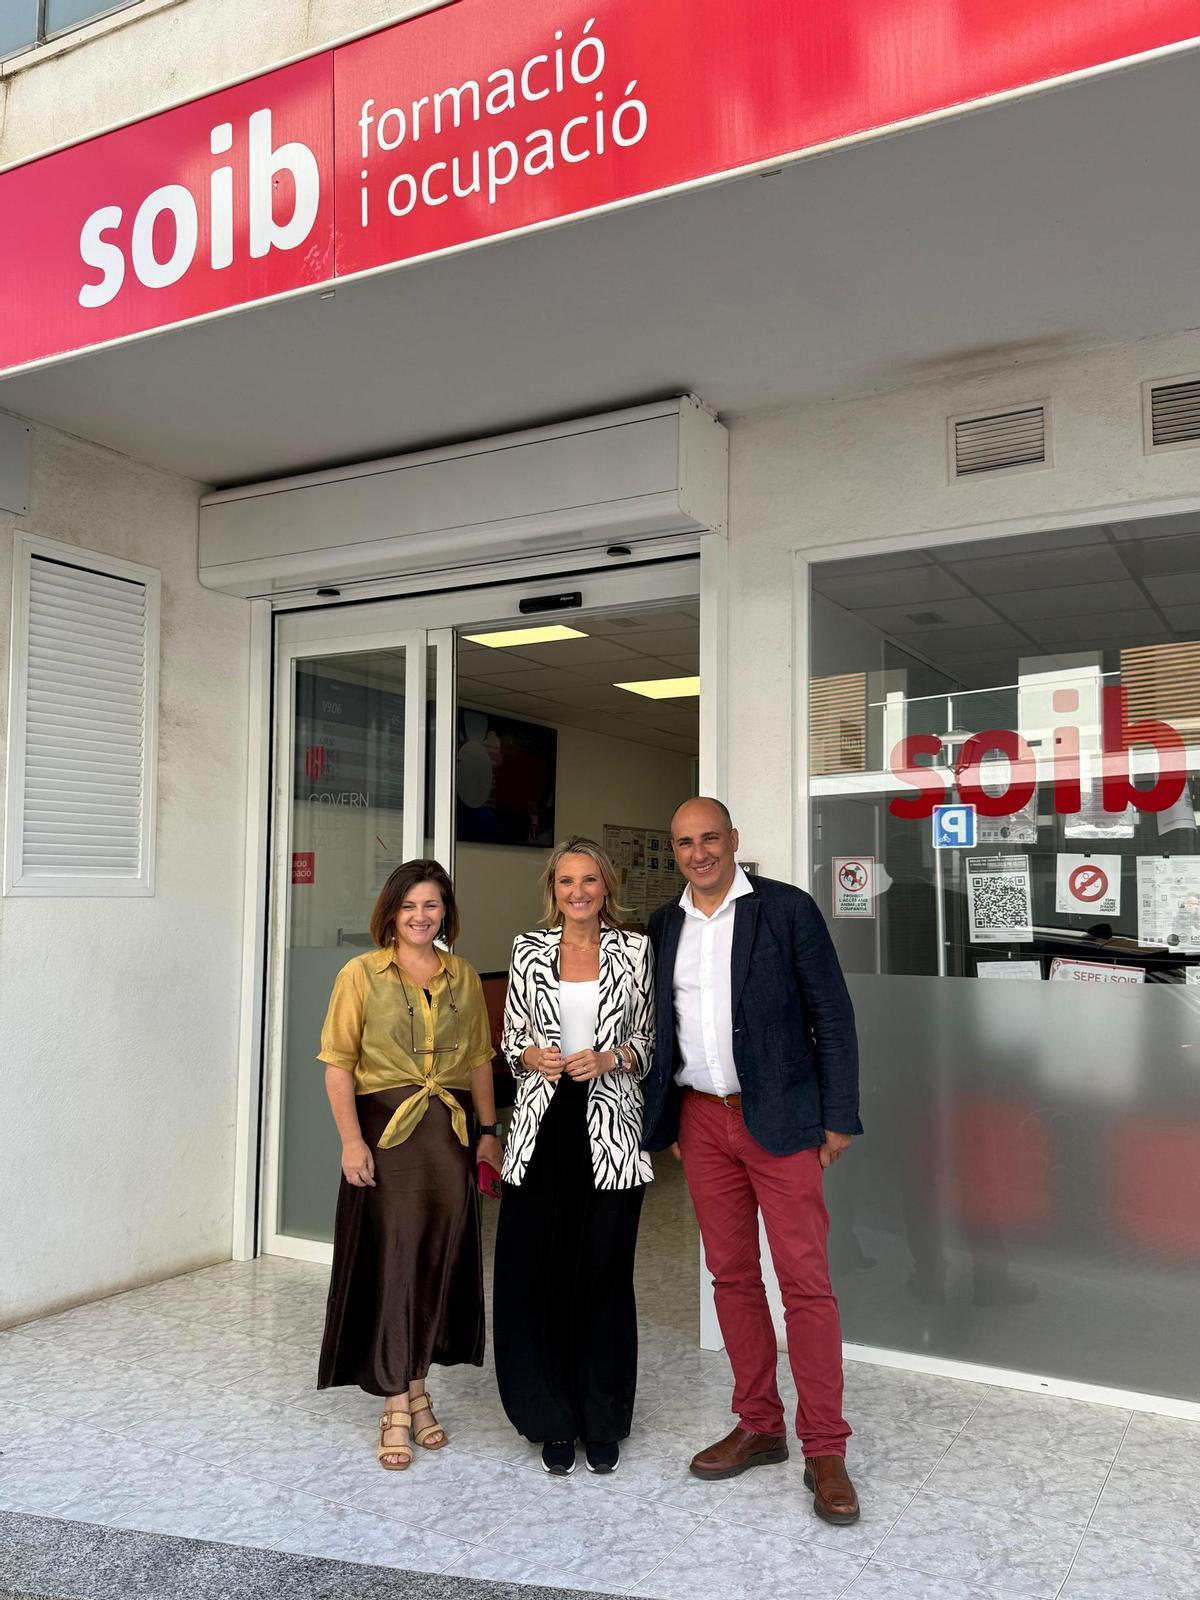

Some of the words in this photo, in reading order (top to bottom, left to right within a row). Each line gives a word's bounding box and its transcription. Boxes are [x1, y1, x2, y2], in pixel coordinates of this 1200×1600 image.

[357, 17, 606, 159] formació
[360, 169, 369, 228] i
[387, 79, 649, 217] ocupació
[78, 108, 320, 308] soib
[889, 685, 1188, 820] soib
[1072, 970, 1102, 982] SEPE
